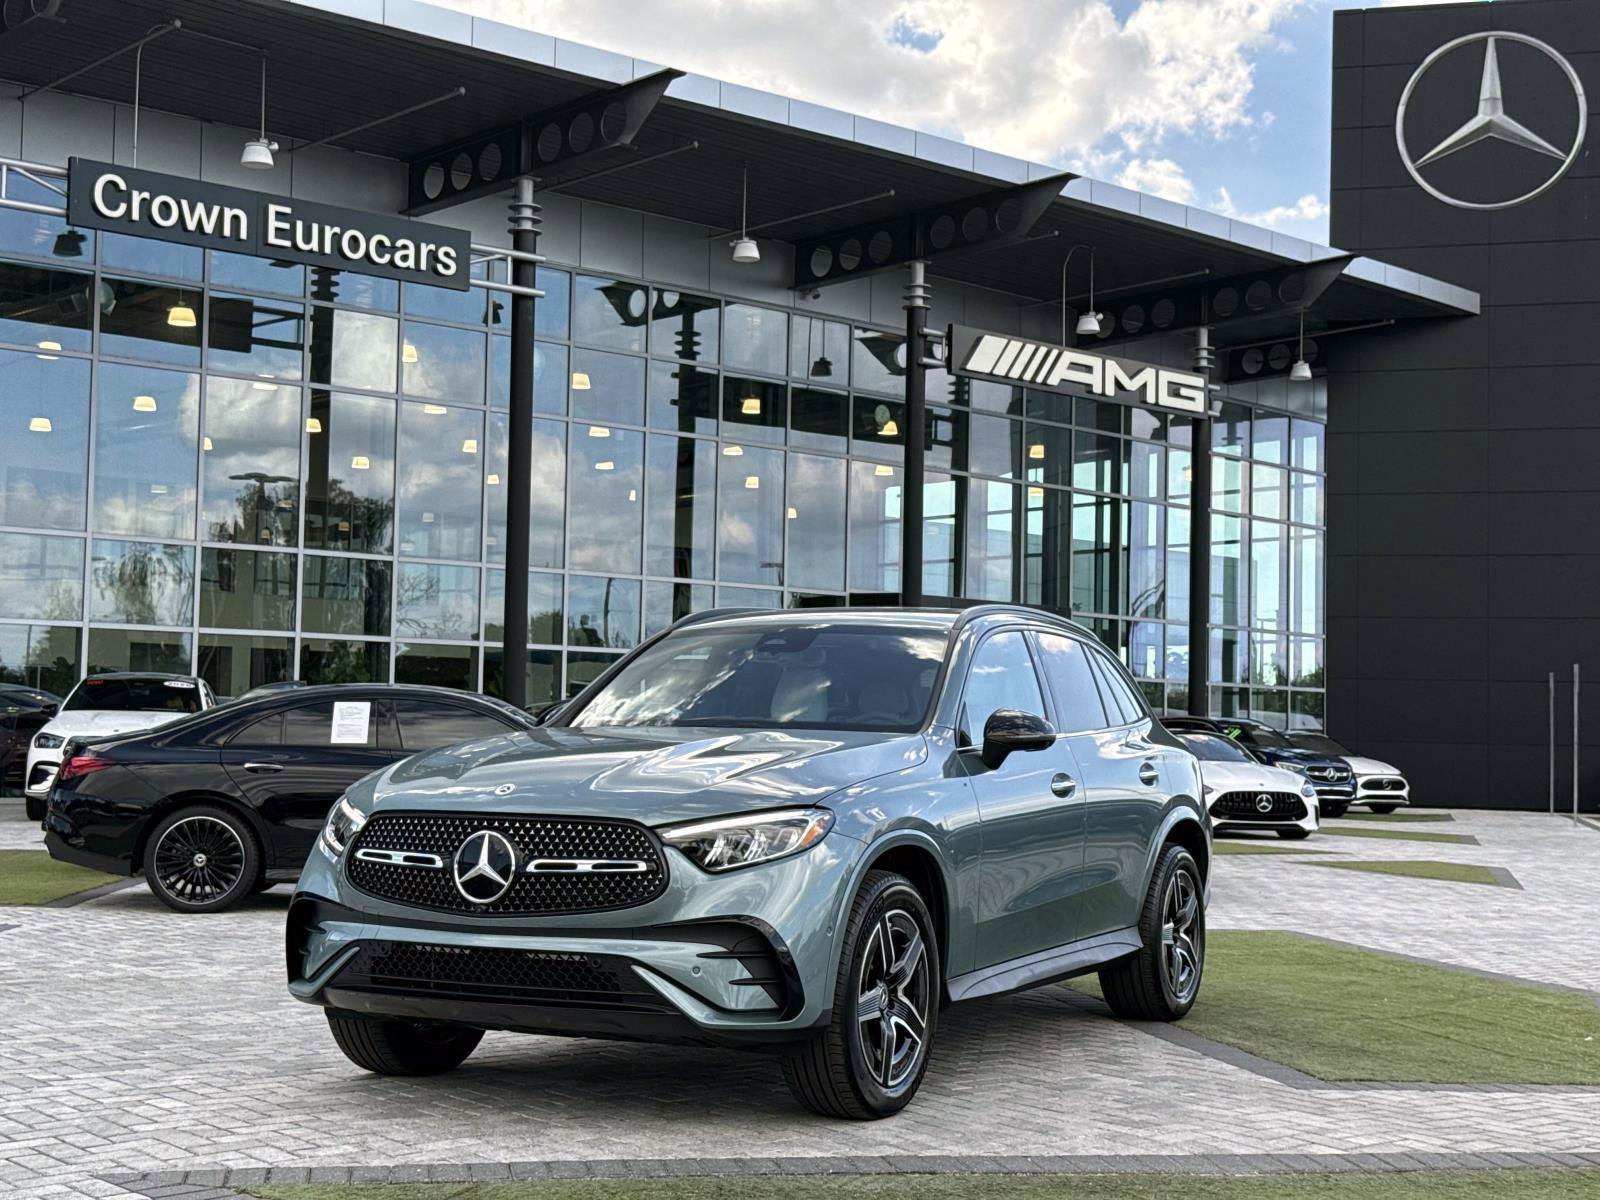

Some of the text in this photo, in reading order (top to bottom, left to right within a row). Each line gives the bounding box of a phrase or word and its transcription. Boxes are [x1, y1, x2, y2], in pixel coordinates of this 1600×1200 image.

[93, 173, 458, 276] Crown Eurocars
[1045, 350, 1205, 413] AMG
